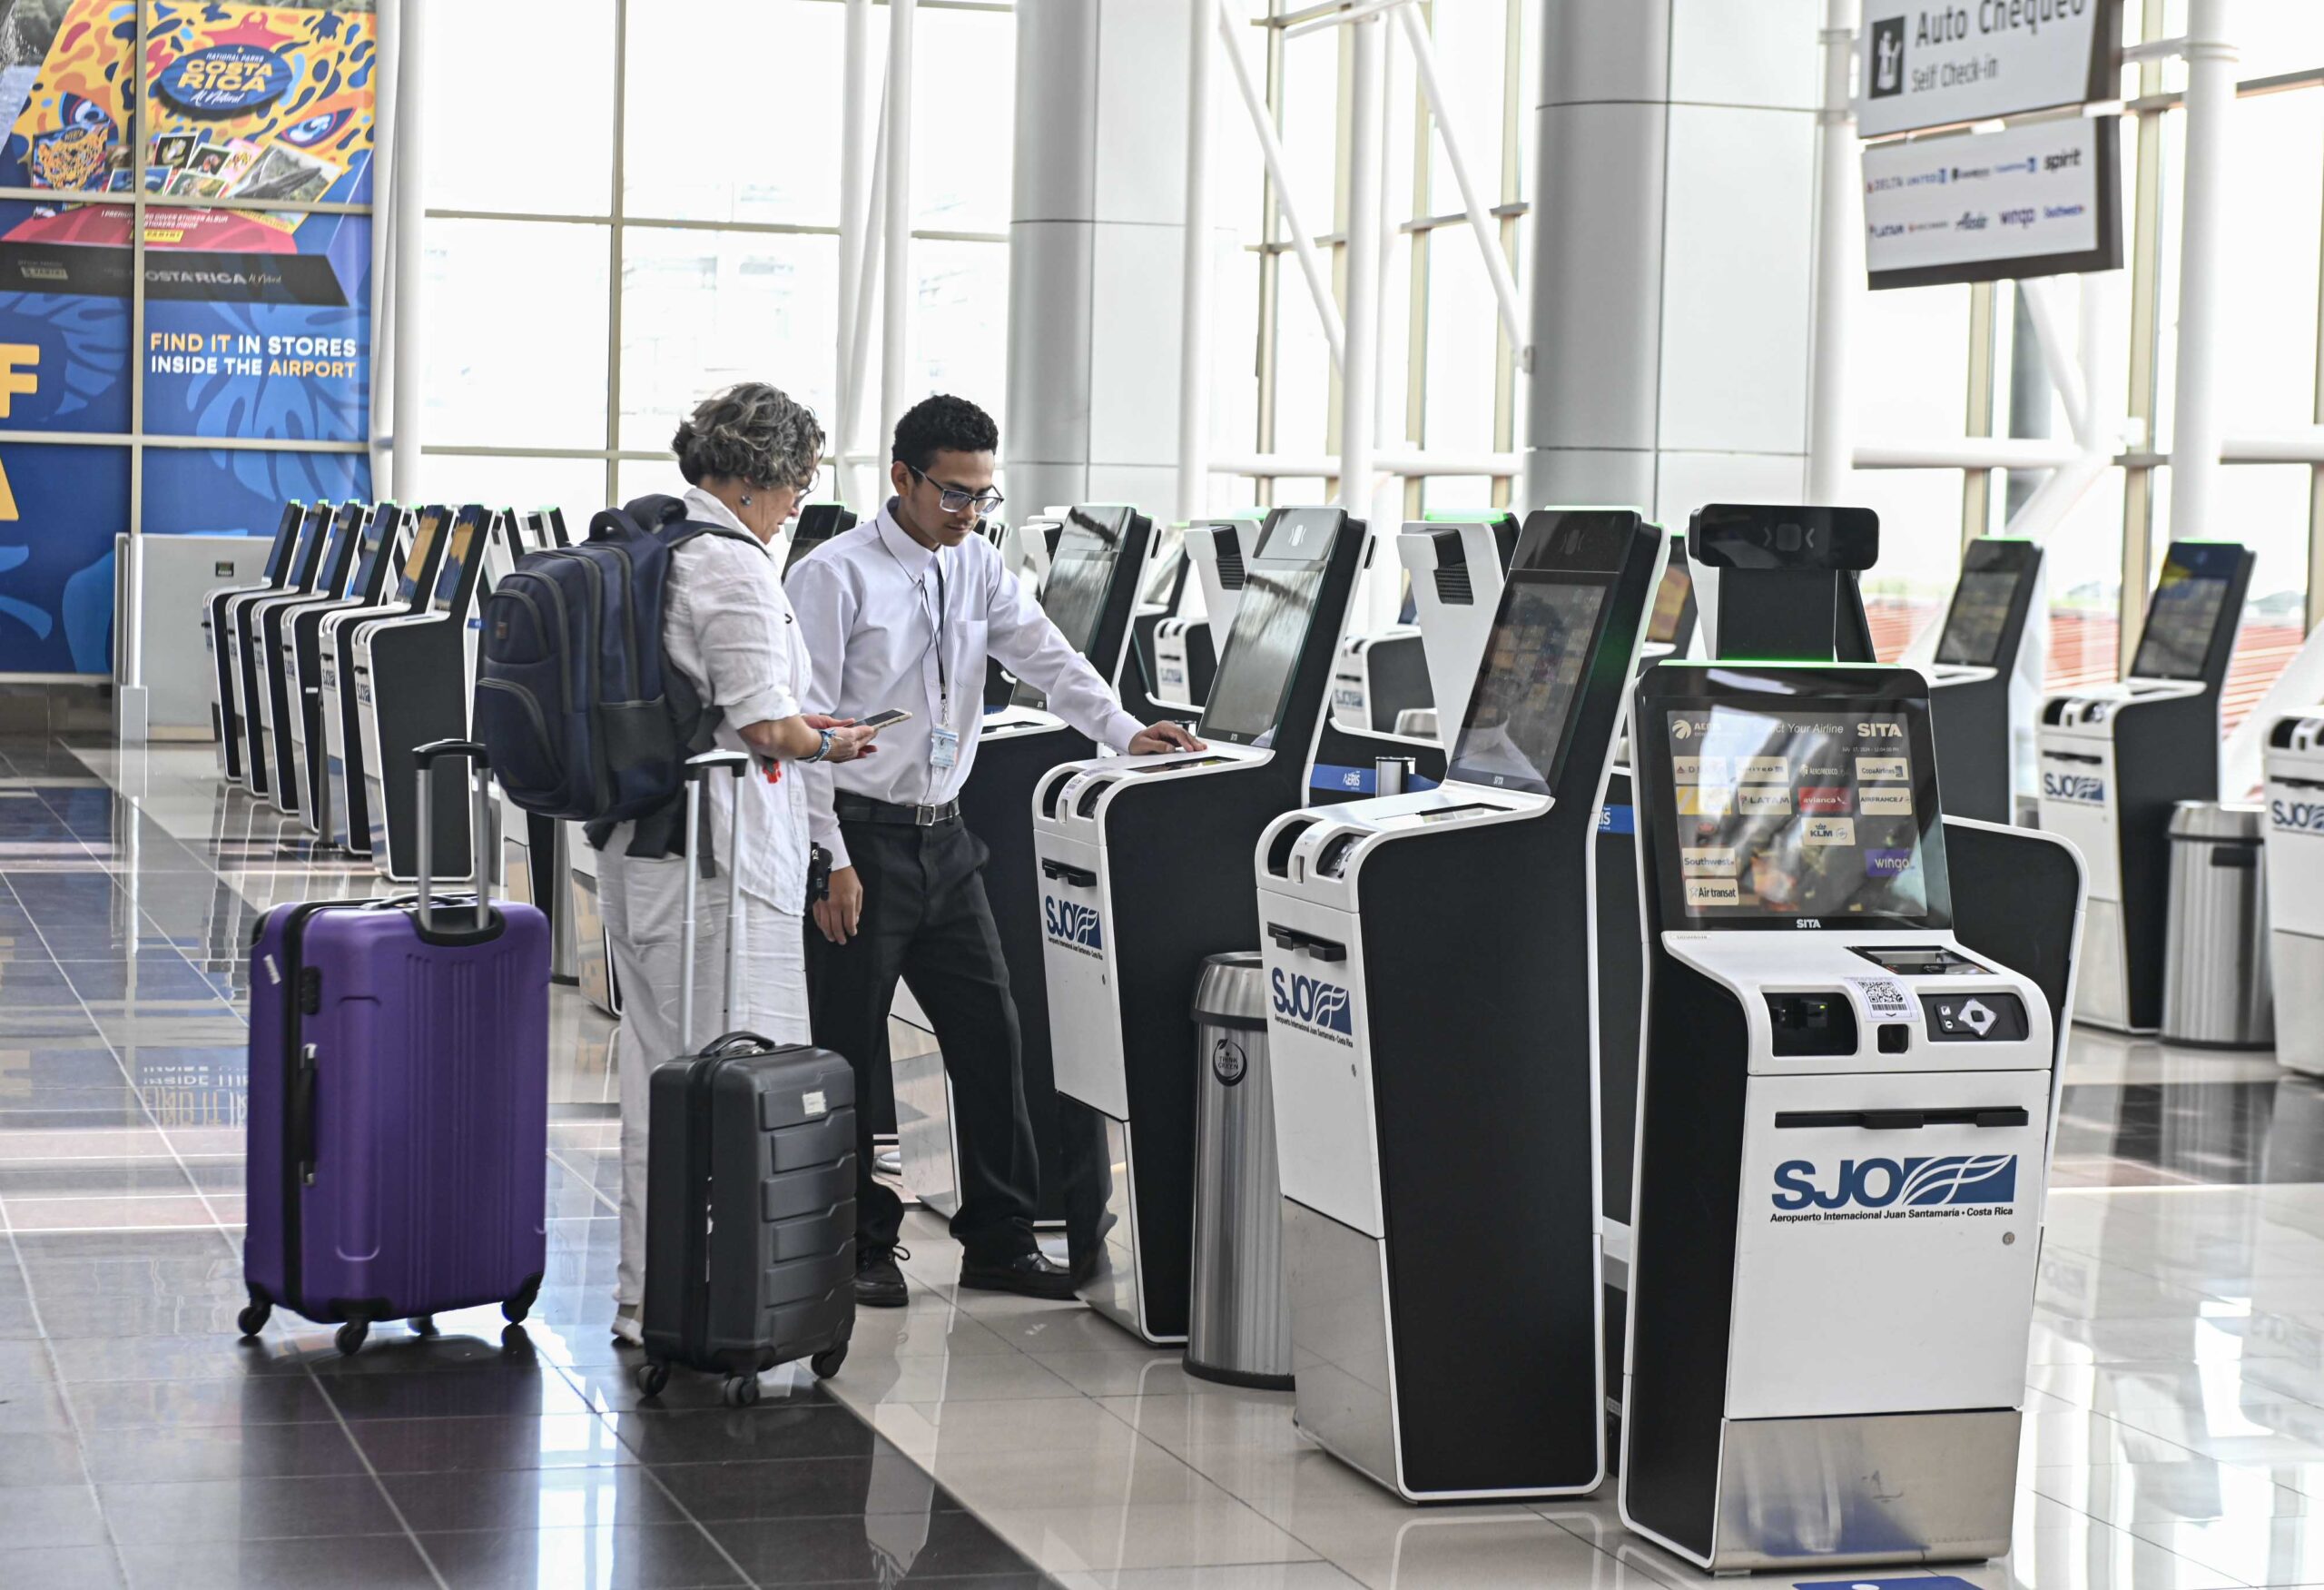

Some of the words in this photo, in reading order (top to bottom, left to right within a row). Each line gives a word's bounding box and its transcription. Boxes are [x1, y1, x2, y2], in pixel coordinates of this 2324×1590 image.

[1915, 5, 1969, 47] Auto
[206, 52, 239, 62] NATIONAL
[186, 59, 272, 77] COSTA
[1912, 64, 1937, 93] Self
[1941, 53, 1998, 88] Check-in
[177, 72, 266, 93] RICA
[2043, 147, 2081, 173] spirit
[144, 270, 193, 283] OSTA
[195, 271, 247, 285] RICA
[151, 332, 203, 352] FIND
[212, 334, 231, 352] IT
[239, 335, 261, 354] IN
[268, 336, 357, 358] STORES
[152, 355, 218, 374] INSIDE
[223, 357, 262, 375] THE
[268, 359, 357, 379] AIRPORT
[1787, 724, 1811, 734] Your
[1812, 724, 1844, 734] Airline
[1856, 723, 1903, 737] SITA
[1343, 772, 1361, 785] AERIS
[2044, 773, 2075, 797] SJO
[1749, 795, 1789, 805] LATAM
[2271, 800, 2309, 827] SJO
[1810, 829, 1833, 837] KLM
[1684, 856, 1731, 865] Southwest
[1874, 856, 1910, 871] wingo
[1046, 894, 1075, 941] SJO
[1797, 918, 1821, 928] SITA
[1272, 966, 1314, 1022] SJO
[1771, 1157, 1903, 1210] SJO
[1770, 1212, 1821, 1224] Aeropuerto
[1823, 1210, 1882, 1220] Internacional
[1884, 1210, 1906, 1220] Juan
[1908, 1207, 1959, 1219] Santamaría
[1966, 1207, 1994, 1217] Costa
[1994, 1206, 2014, 1216] Rica
